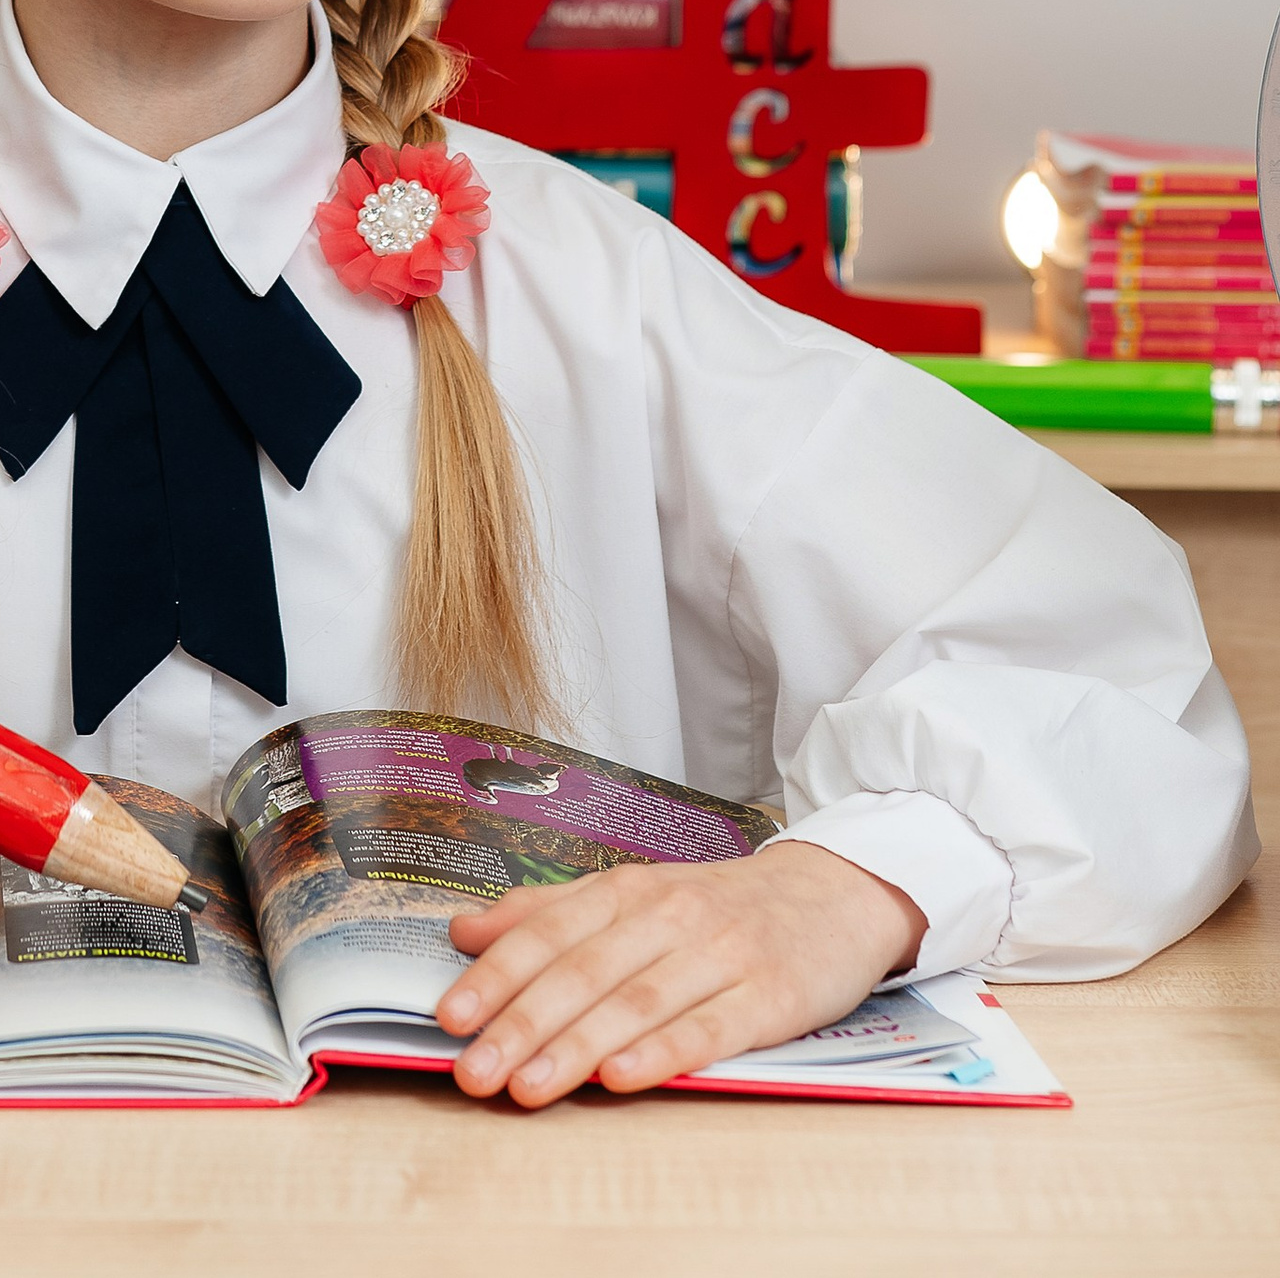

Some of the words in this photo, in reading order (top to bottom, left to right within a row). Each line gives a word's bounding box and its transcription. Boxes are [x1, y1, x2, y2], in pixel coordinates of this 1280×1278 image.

[394, 751, 450, 763] Индюк
[327, 785, 398, 794] медведь
[17, 949, 87, 962] ШАХТЫ
[92, 948, 188, 963] УГОЛЬНЫЕ
